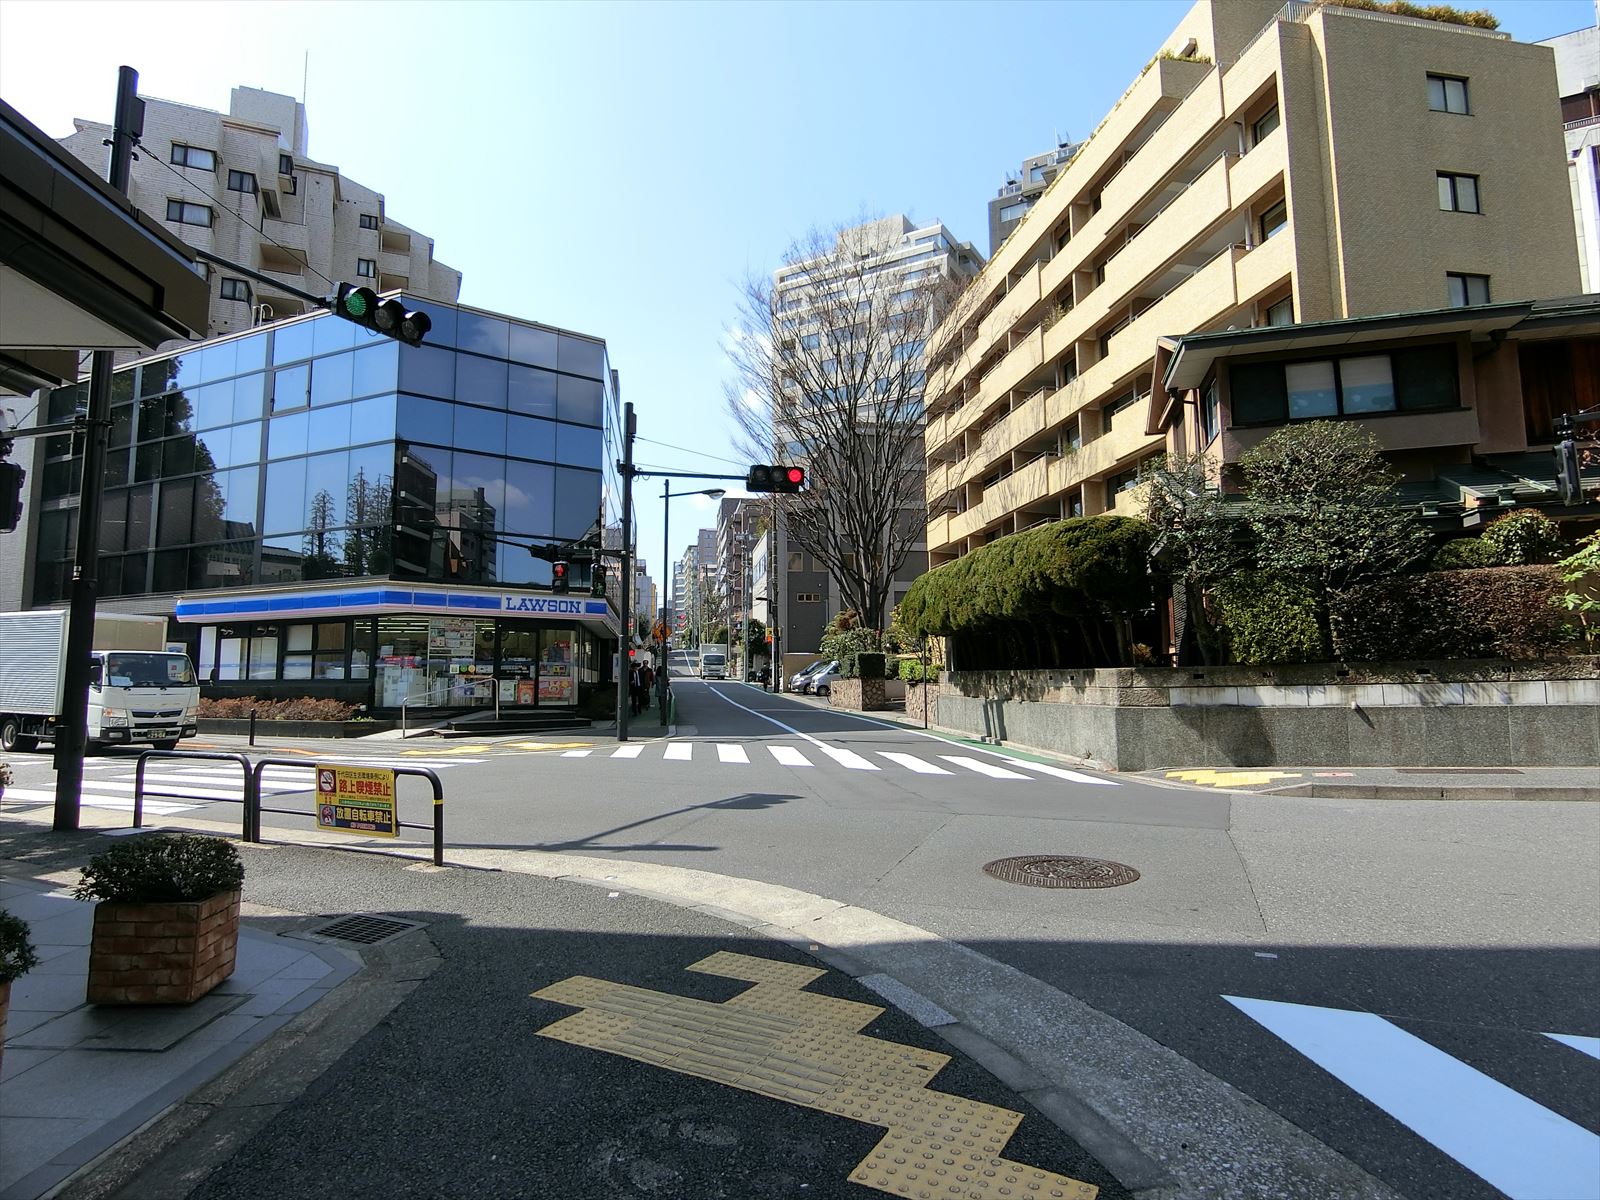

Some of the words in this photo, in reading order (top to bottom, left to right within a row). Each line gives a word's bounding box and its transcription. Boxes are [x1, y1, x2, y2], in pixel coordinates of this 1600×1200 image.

[505, 597, 582, 613] LAWSON
[339, 779, 392, 796] 路上喫煙禁止
[336, 807, 392, 824] 放置自転車禁止
